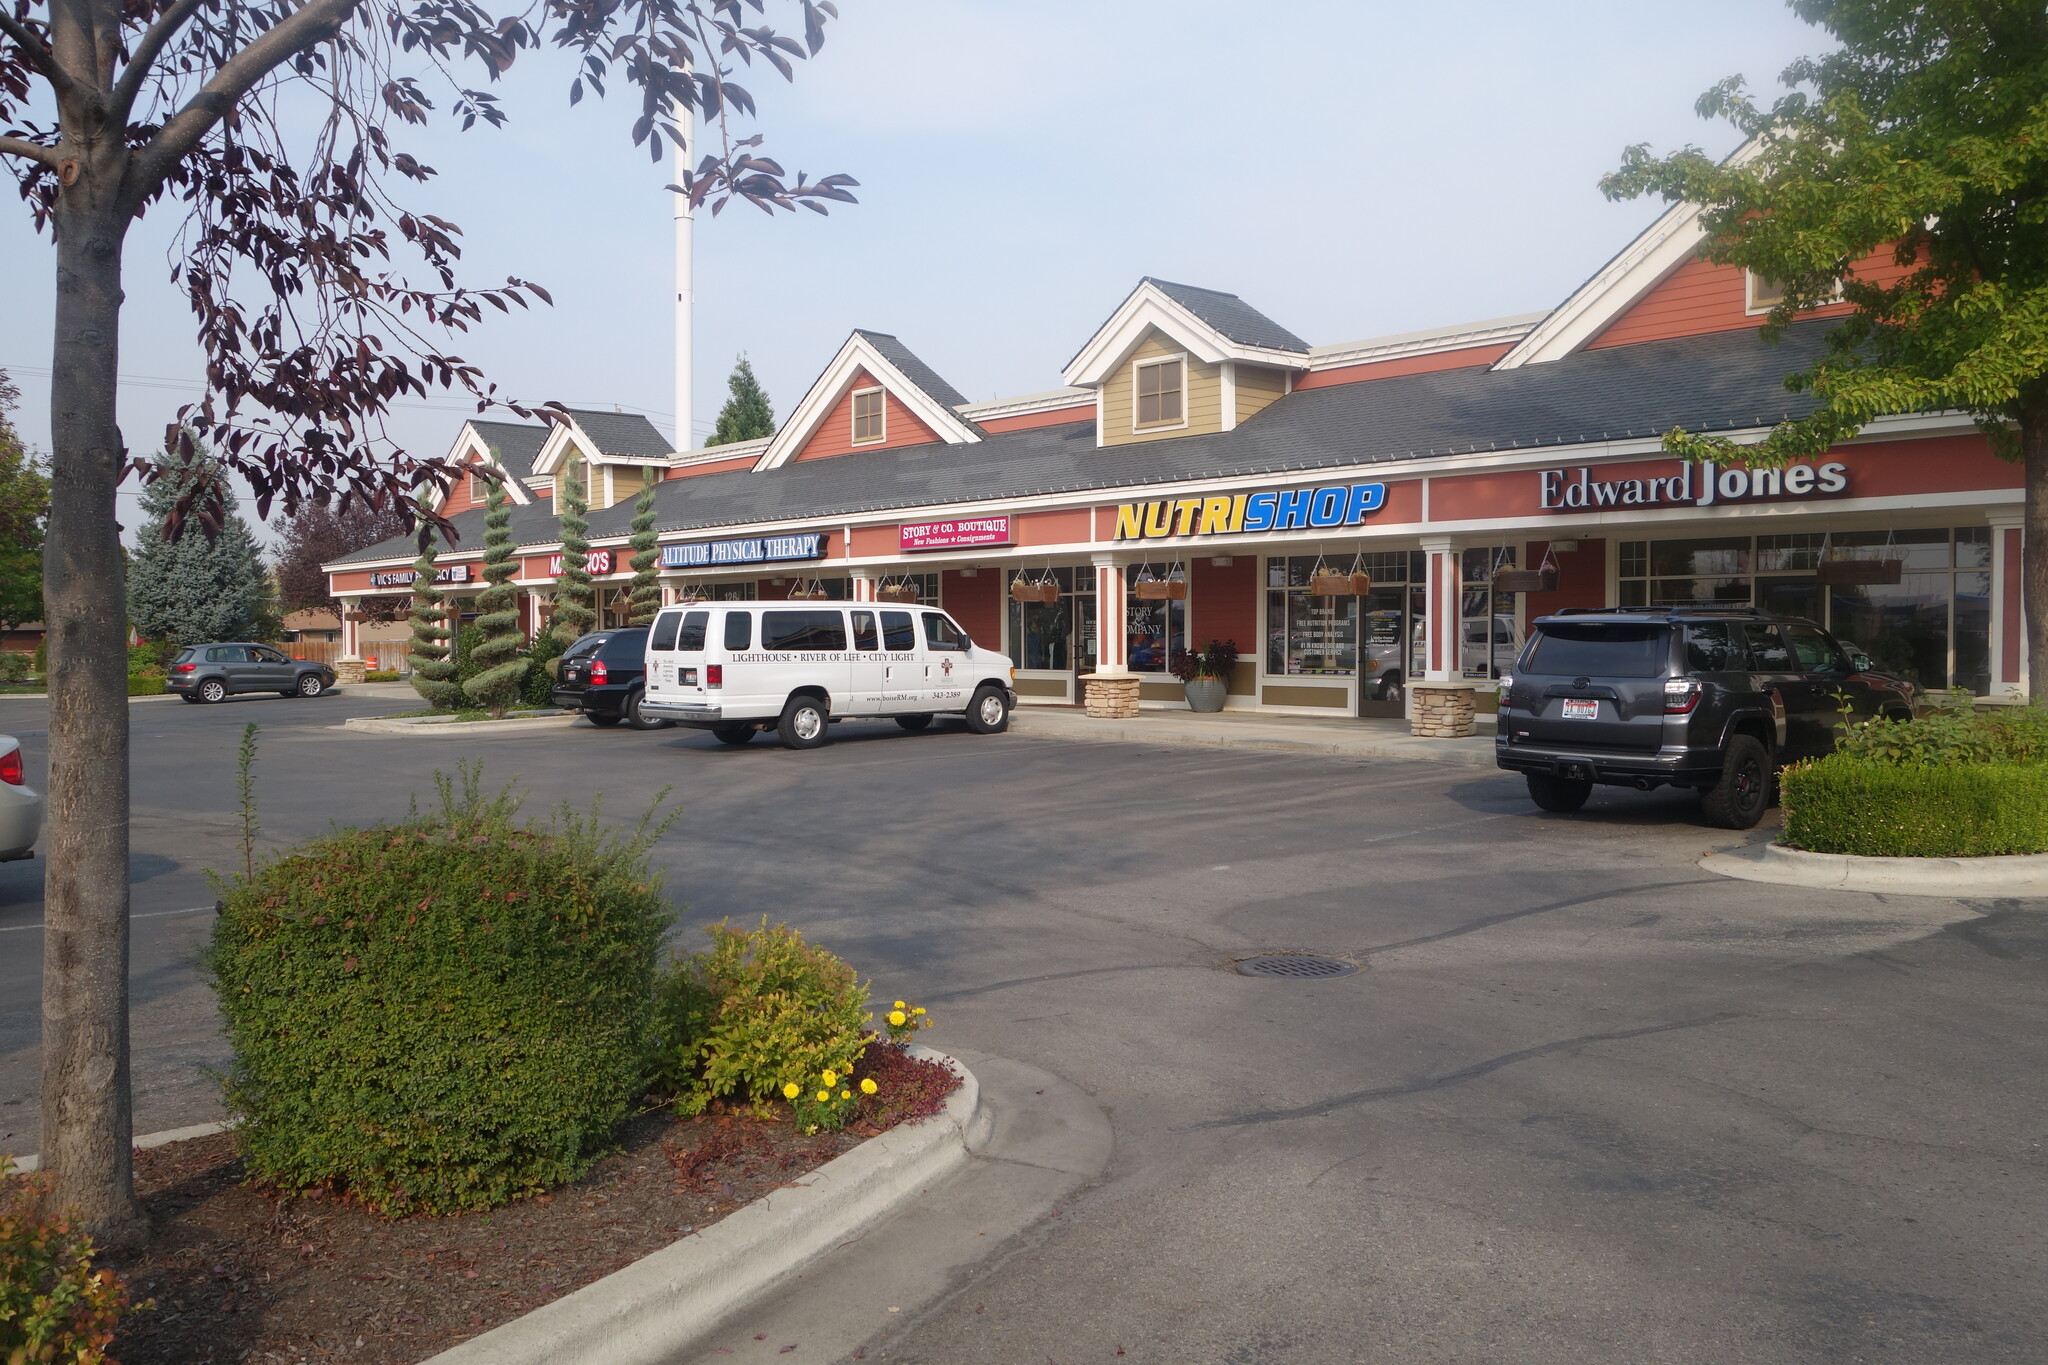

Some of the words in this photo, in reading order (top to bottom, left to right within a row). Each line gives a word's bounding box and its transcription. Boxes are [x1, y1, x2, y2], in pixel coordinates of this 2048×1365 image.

[1536, 460, 1693, 510] Edward
[1696, 458, 1848, 507] Jones
[1113, 482, 1386, 541] NUTRISHOP
[902, 525, 931, 540] STORY
[932, 524, 940, 534] &
[941, 523, 955, 533] CO.
[957, 518, 1007, 532] BOUTIQUE
[913, 538, 924, 546] New
[925, 537, 949, 545] Fashions
[956, 533, 996, 543] Consignments
[661, 543, 709, 565] ALTITUDE
[711, 540, 763, 562] PHYSICAL
[765, 535, 821, 558] THERAPY
[550, 551, 609, 575] MANO'S
[376, 573, 392, 585] VIC'S
[392, 571, 414, 584] FAMILY
[415, 568, 450, 581] PACY
[1126, 606, 1153, 617] STORY
[1126, 624, 1162, 634] OMPANY
[732, 653, 792, 662] LIGHTHOUSE
[800, 653, 827, 662] RIVER
[829, 653, 841, 661] OF
[844, 653, 861, 661] LIFE
[868, 653, 889, 661] CITY
[890, 653, 915, 661] LIGHT
[1325, 648, 1343, 656] SERVICE
[866, 694, 917, 702] www.boiseRM.org
